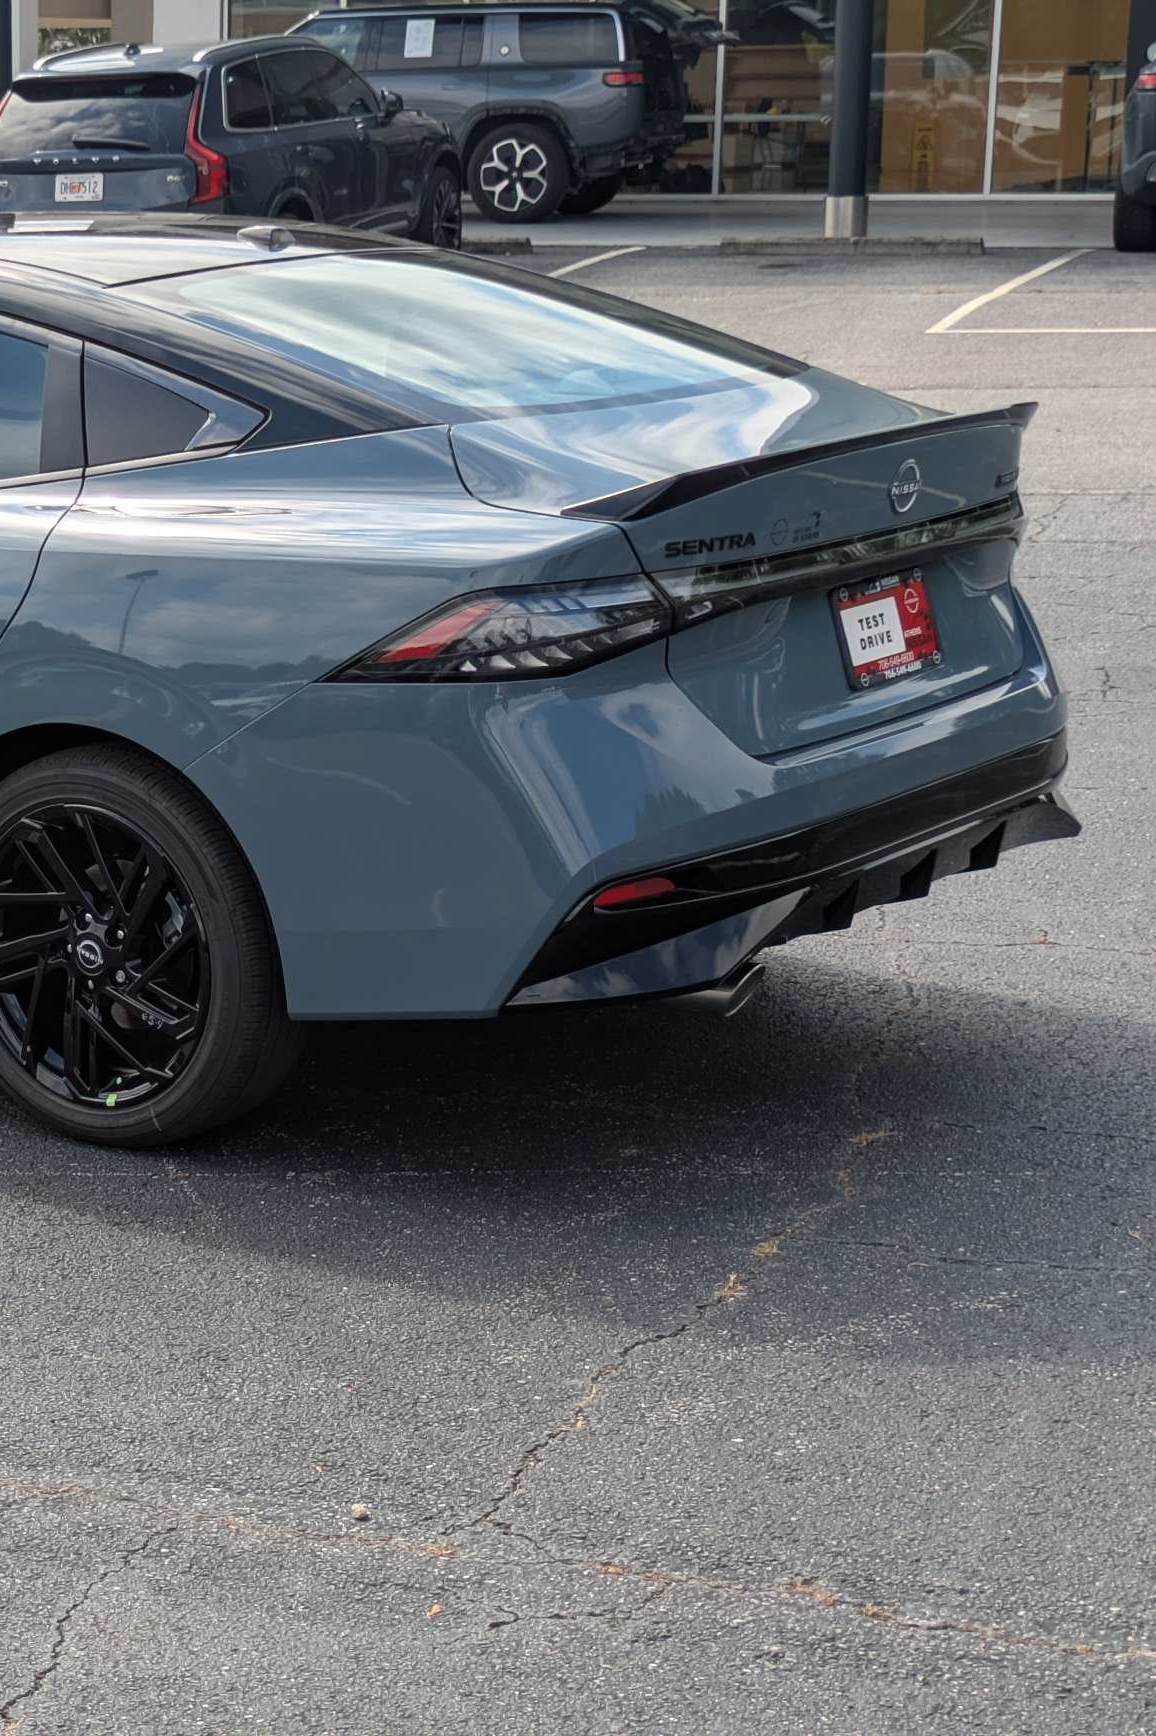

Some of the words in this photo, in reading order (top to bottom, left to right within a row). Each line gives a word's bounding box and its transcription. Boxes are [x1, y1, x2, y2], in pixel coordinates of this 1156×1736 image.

[32, 155, 120, 165] VOLVO
[664, 531, 756, 558] SENTRA
[858, 612, 885, 631] TEST
[860, 630, 893, 650] DRIVE
